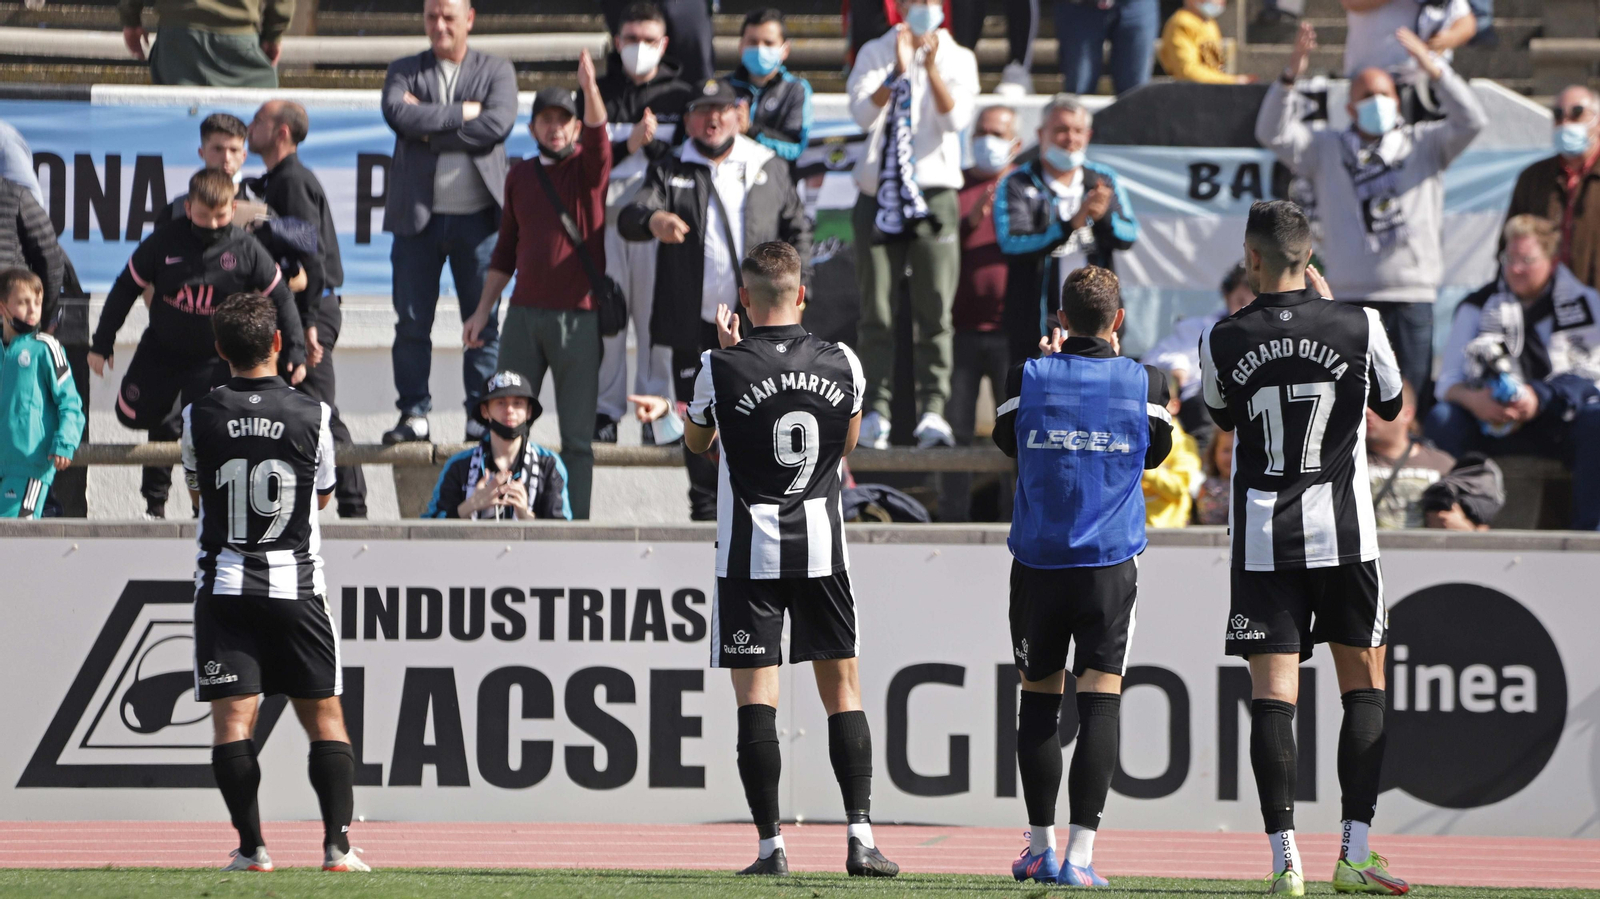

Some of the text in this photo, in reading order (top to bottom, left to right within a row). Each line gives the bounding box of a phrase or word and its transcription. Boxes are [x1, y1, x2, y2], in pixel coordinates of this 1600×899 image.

[1232, 338, 1349, 386] GERARD OLIVA
[734, 372, 845, 416] IVÁN MARTÍN
[226, 417, 285, 440] CHIRO
[772, 410, 819, 495] 9
[1026, 429, 1130, 453] LEGEA
[1246, 381, 1337, 477] 17
[215, 458, 297, 544] 19
[341, 586, 707, 642] INDUSTRIAS
[737, 644, 766, 655] Galán
[1393, 644, 1537, 713] inea
[339, 665, 706, 790] LACSE
